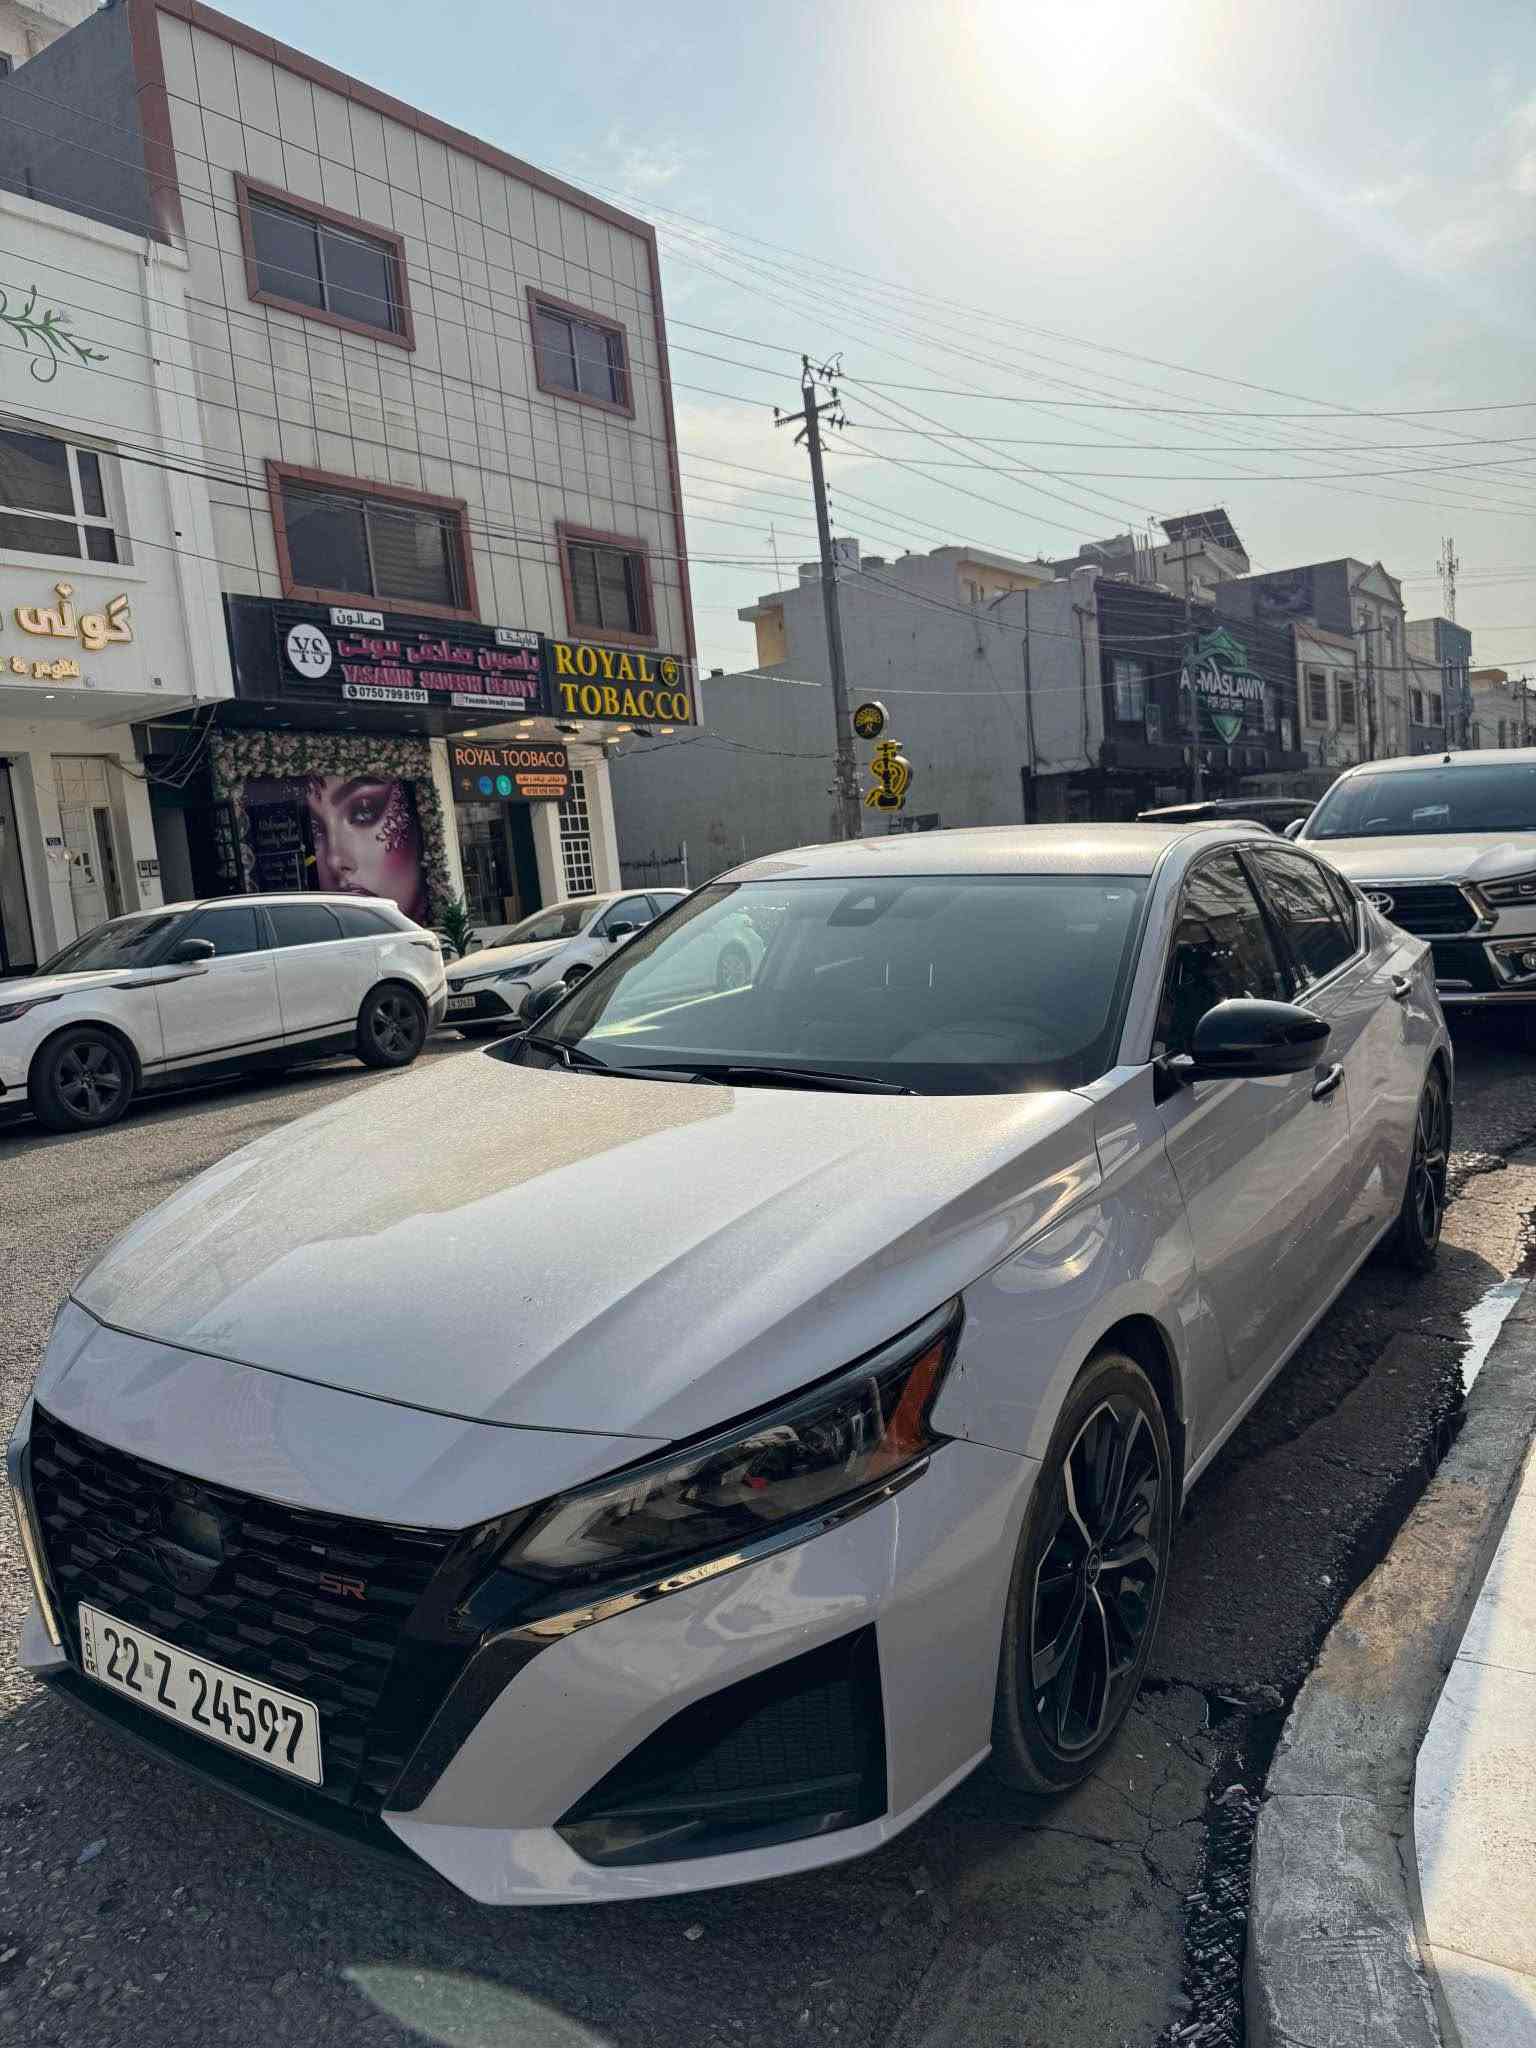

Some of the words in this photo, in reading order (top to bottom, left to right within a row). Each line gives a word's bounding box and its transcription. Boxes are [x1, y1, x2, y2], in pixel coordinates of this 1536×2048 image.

[292, 636, 325, 665] YS
[553, 644, 655, 682] ROYAL
[359, 685, 383, 698] 0750
[386, 688, 403, 699] 799
[404, 690, 425, 702] 8191
[560, 683, 690, 720] TOBACCO
[455, 748, 500, 767] ROYAL
[501, 750, 565, 768] TOOBACO
[104, 1628, 142, 1692] 22
[153, 1650, 177, 1710] Z
[188, 1668, 304, 1764] 24597
